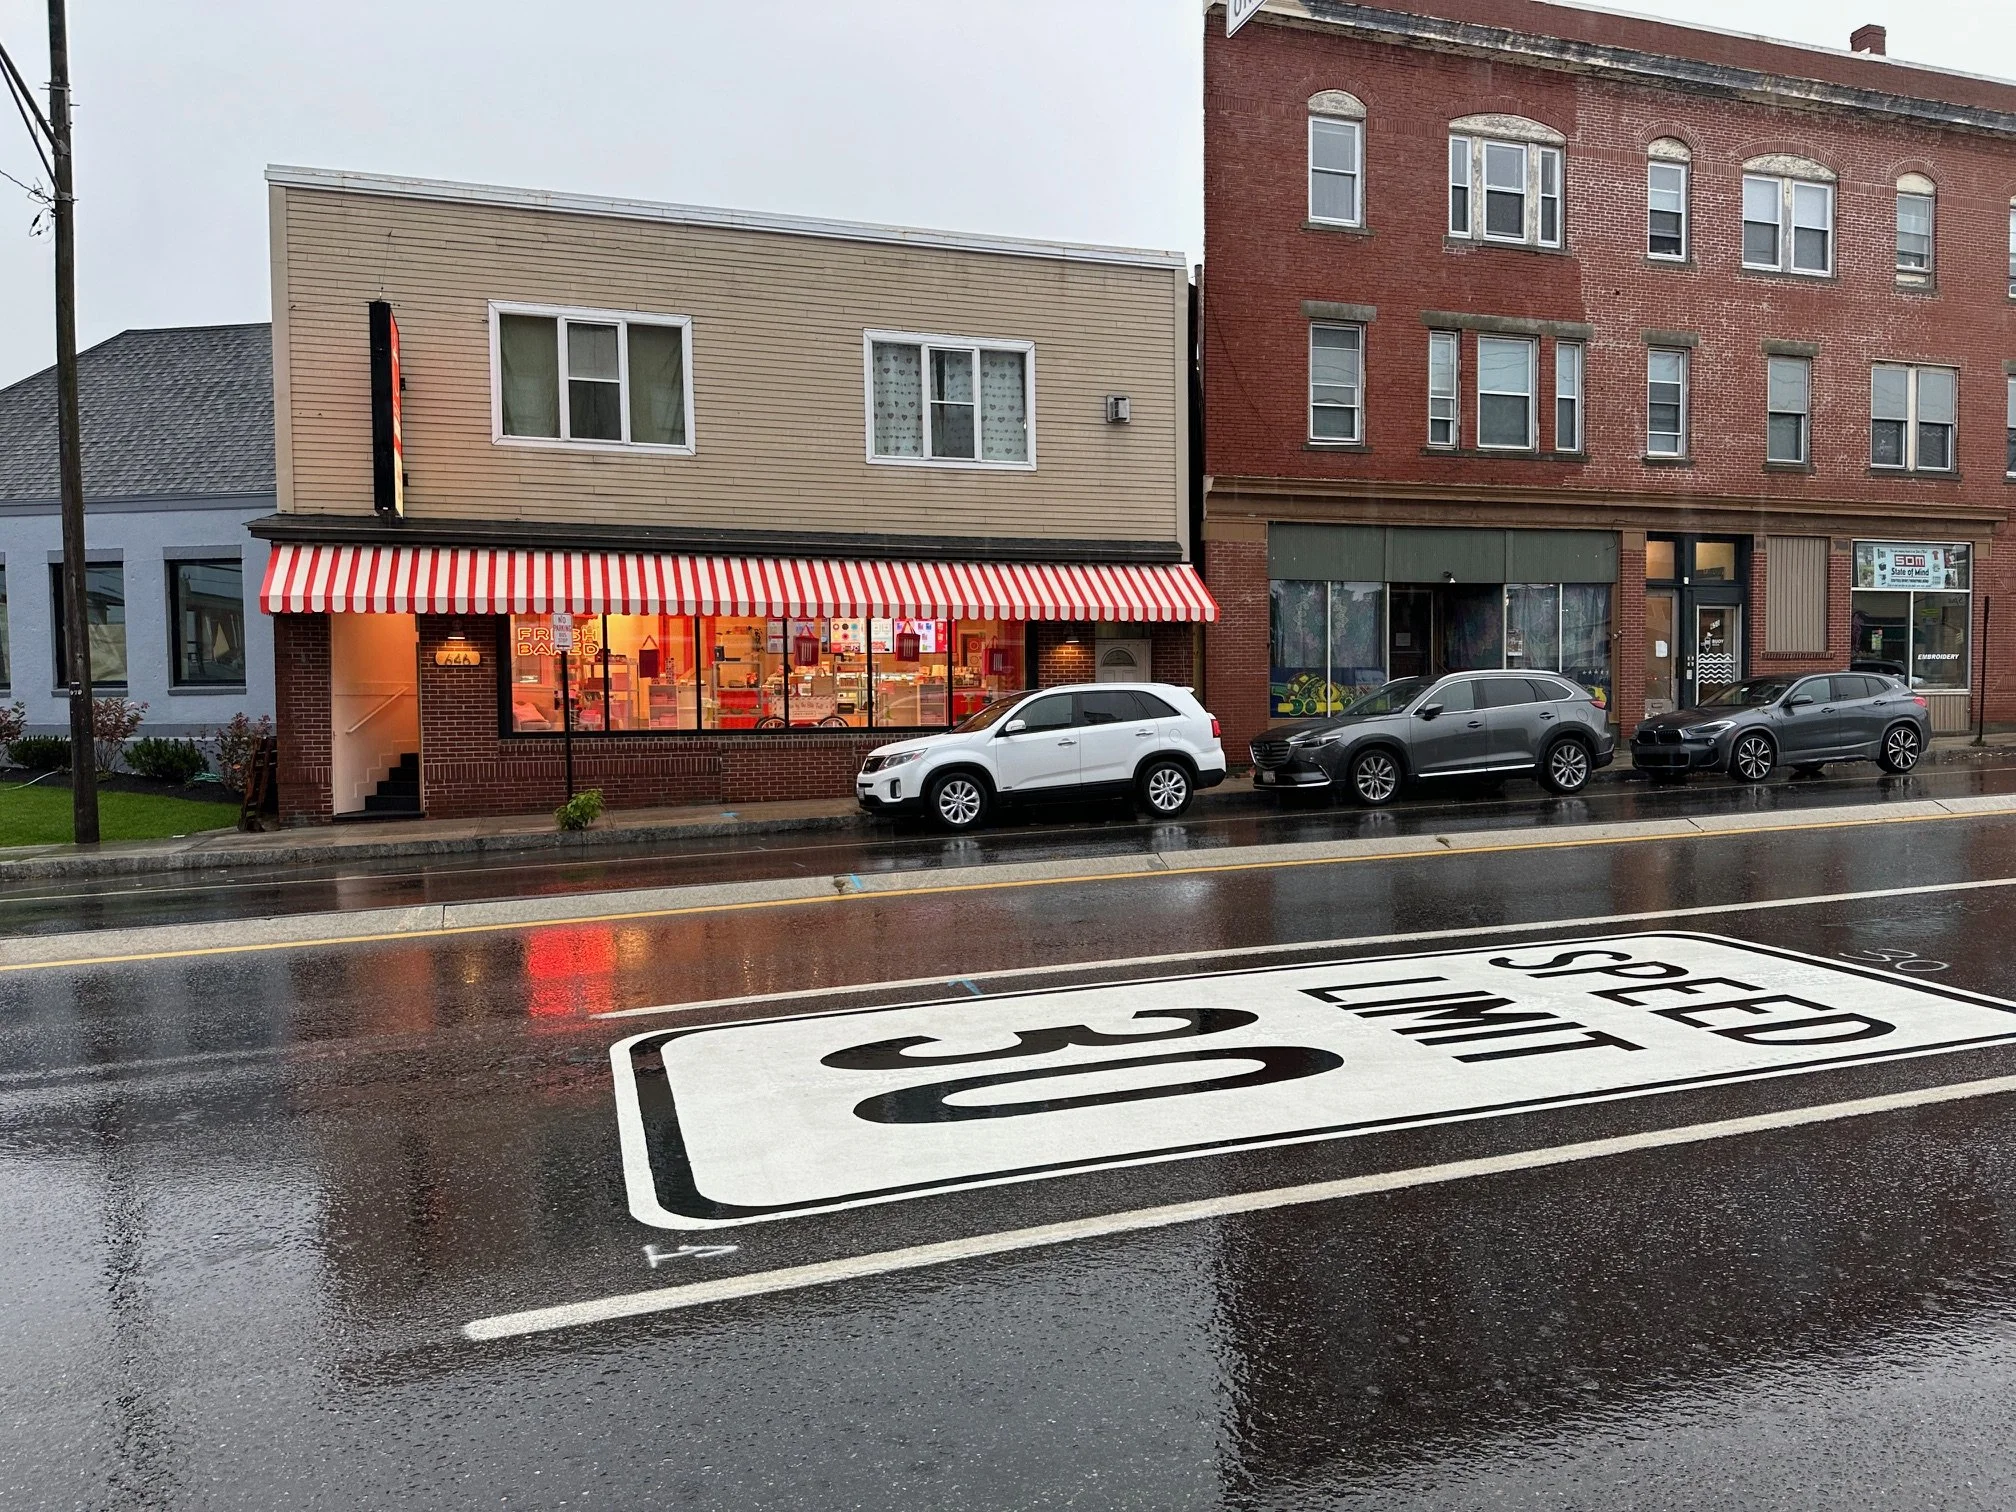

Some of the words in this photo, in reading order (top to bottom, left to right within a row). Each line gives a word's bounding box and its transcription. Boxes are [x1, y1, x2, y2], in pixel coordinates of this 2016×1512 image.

[1891, 567, 1906, 576] State
[1907, 568, 1914, 577] of
[1915, 568, 1930, 576] Mind
[558, 616, 567, 624] NO
[517, 627, 598, 641] FRSH
[444, 653, 471, 665] 646
[1489, 949, 1896, 1047] SPEED
[1297, 976, 1648, 1064] LIMIT
[820, 1007, 1345, 1125] 30
